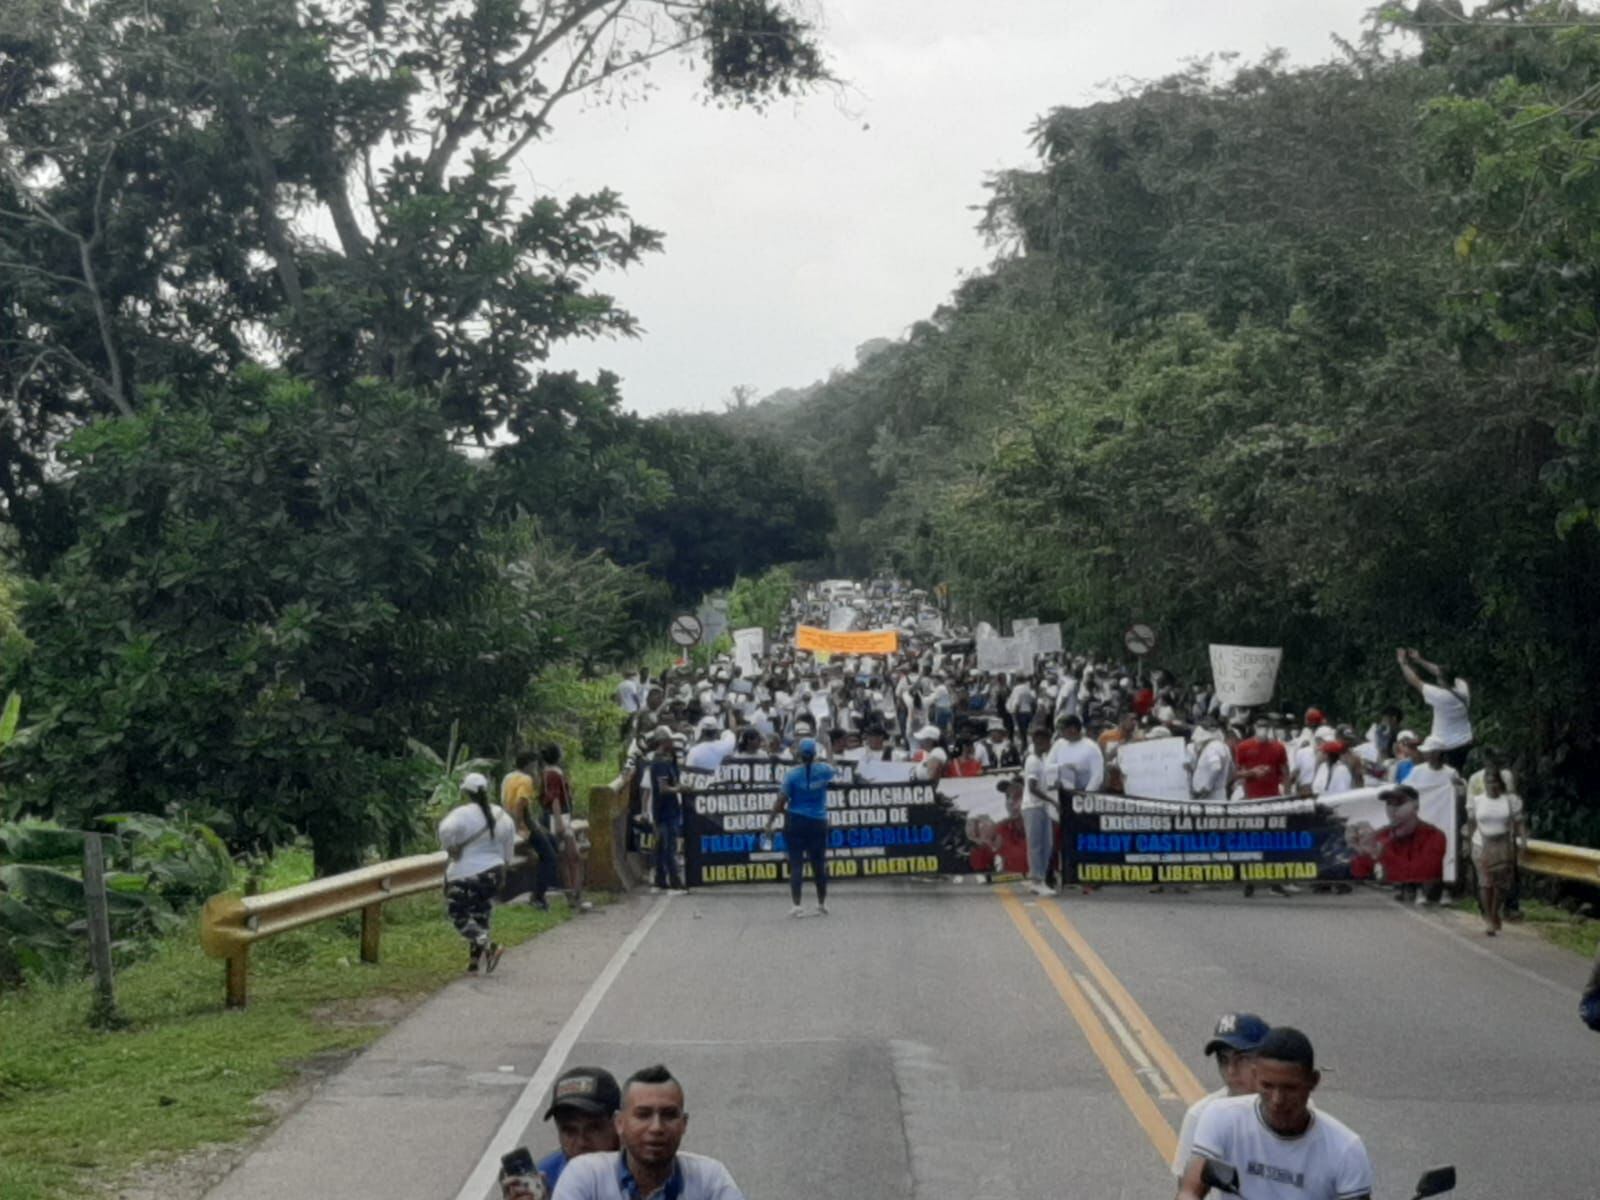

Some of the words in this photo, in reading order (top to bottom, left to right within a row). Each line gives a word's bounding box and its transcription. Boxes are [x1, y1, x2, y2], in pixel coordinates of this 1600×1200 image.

[848, 785, 935, 806] GUACHACA
[1195, 816, 1266, 831] LIBERTAD
[702, 862, 778, 882] LIBERTAD
[863, 855, 939, 876] LIBERTAD
[1077, 863, 1153, 882] LIBERTAD
[1157, 864, 1235, 882] LIBERTAD
[1239, 861, 1319, 881] LIBERTAD
